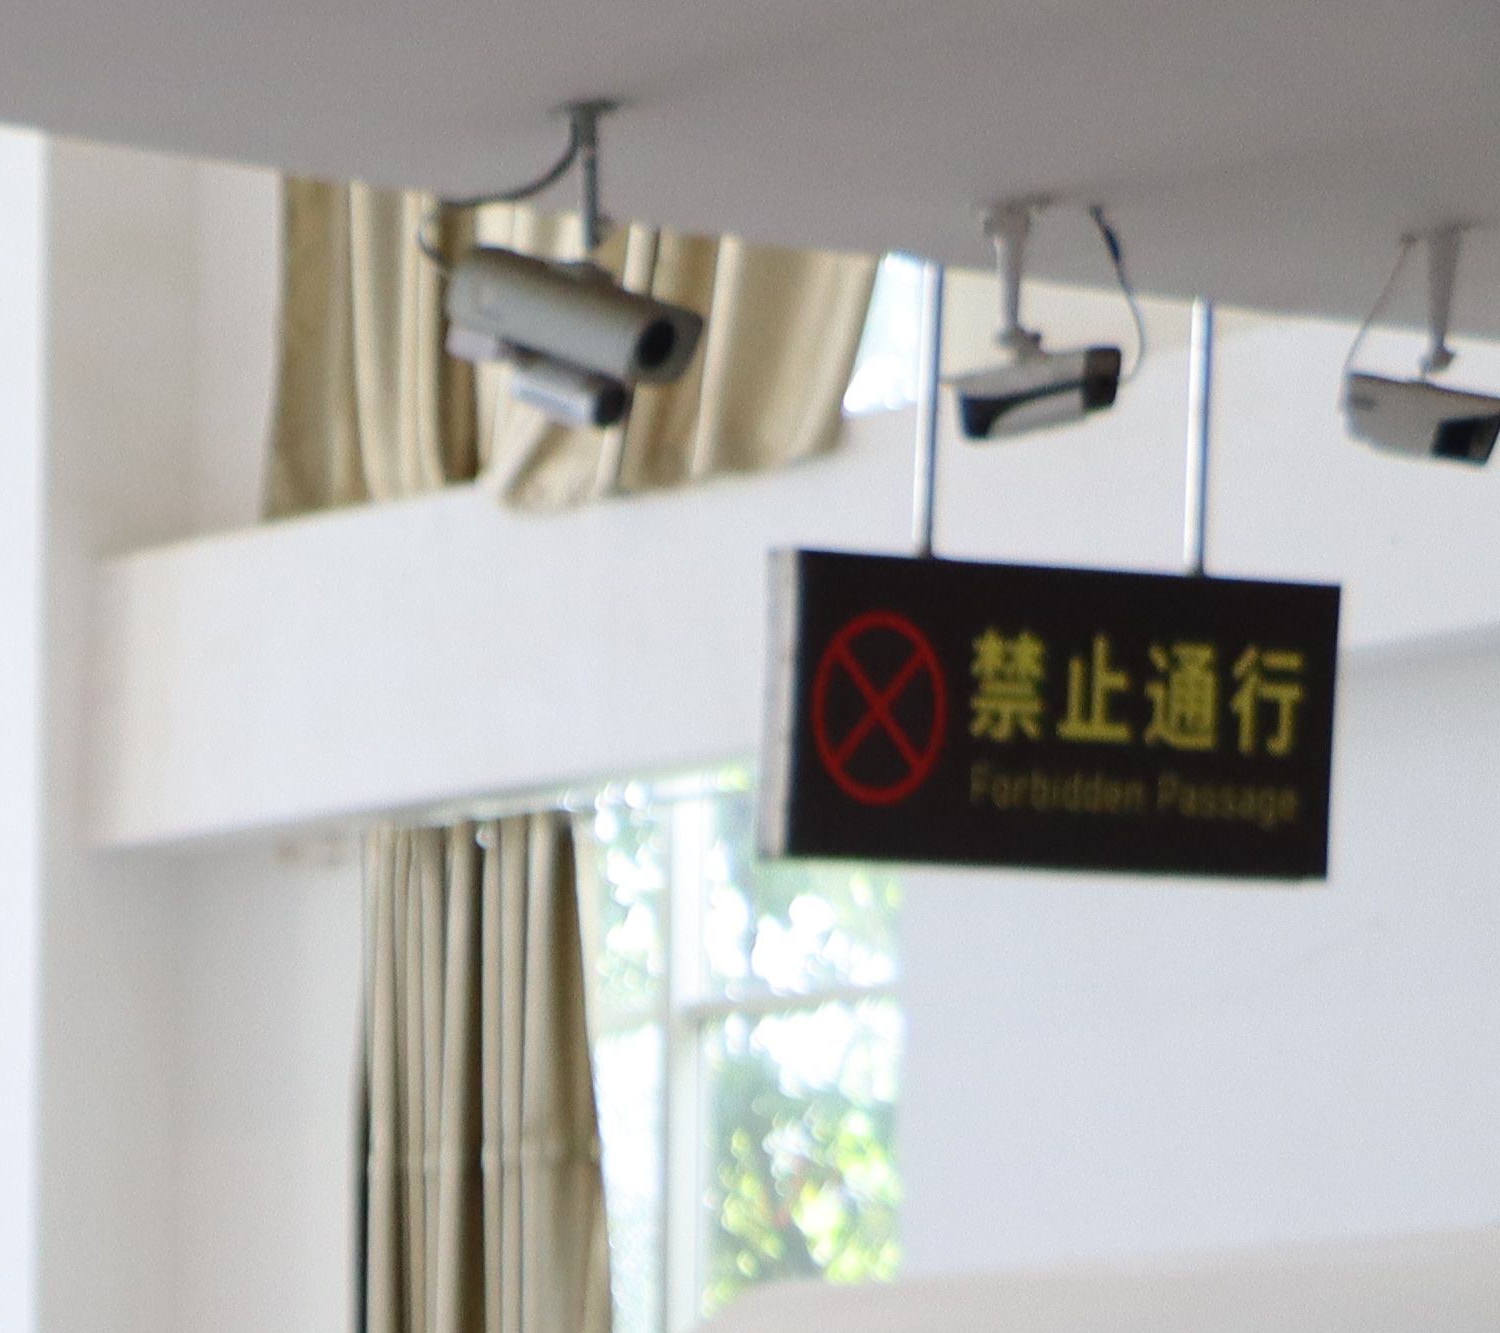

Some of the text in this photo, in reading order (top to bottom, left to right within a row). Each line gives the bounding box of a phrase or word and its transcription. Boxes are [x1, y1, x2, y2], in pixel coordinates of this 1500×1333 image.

[969, 624, 1305, 756] 禁止通行
[969, 762, 1300, 831] Forbidden Passage
